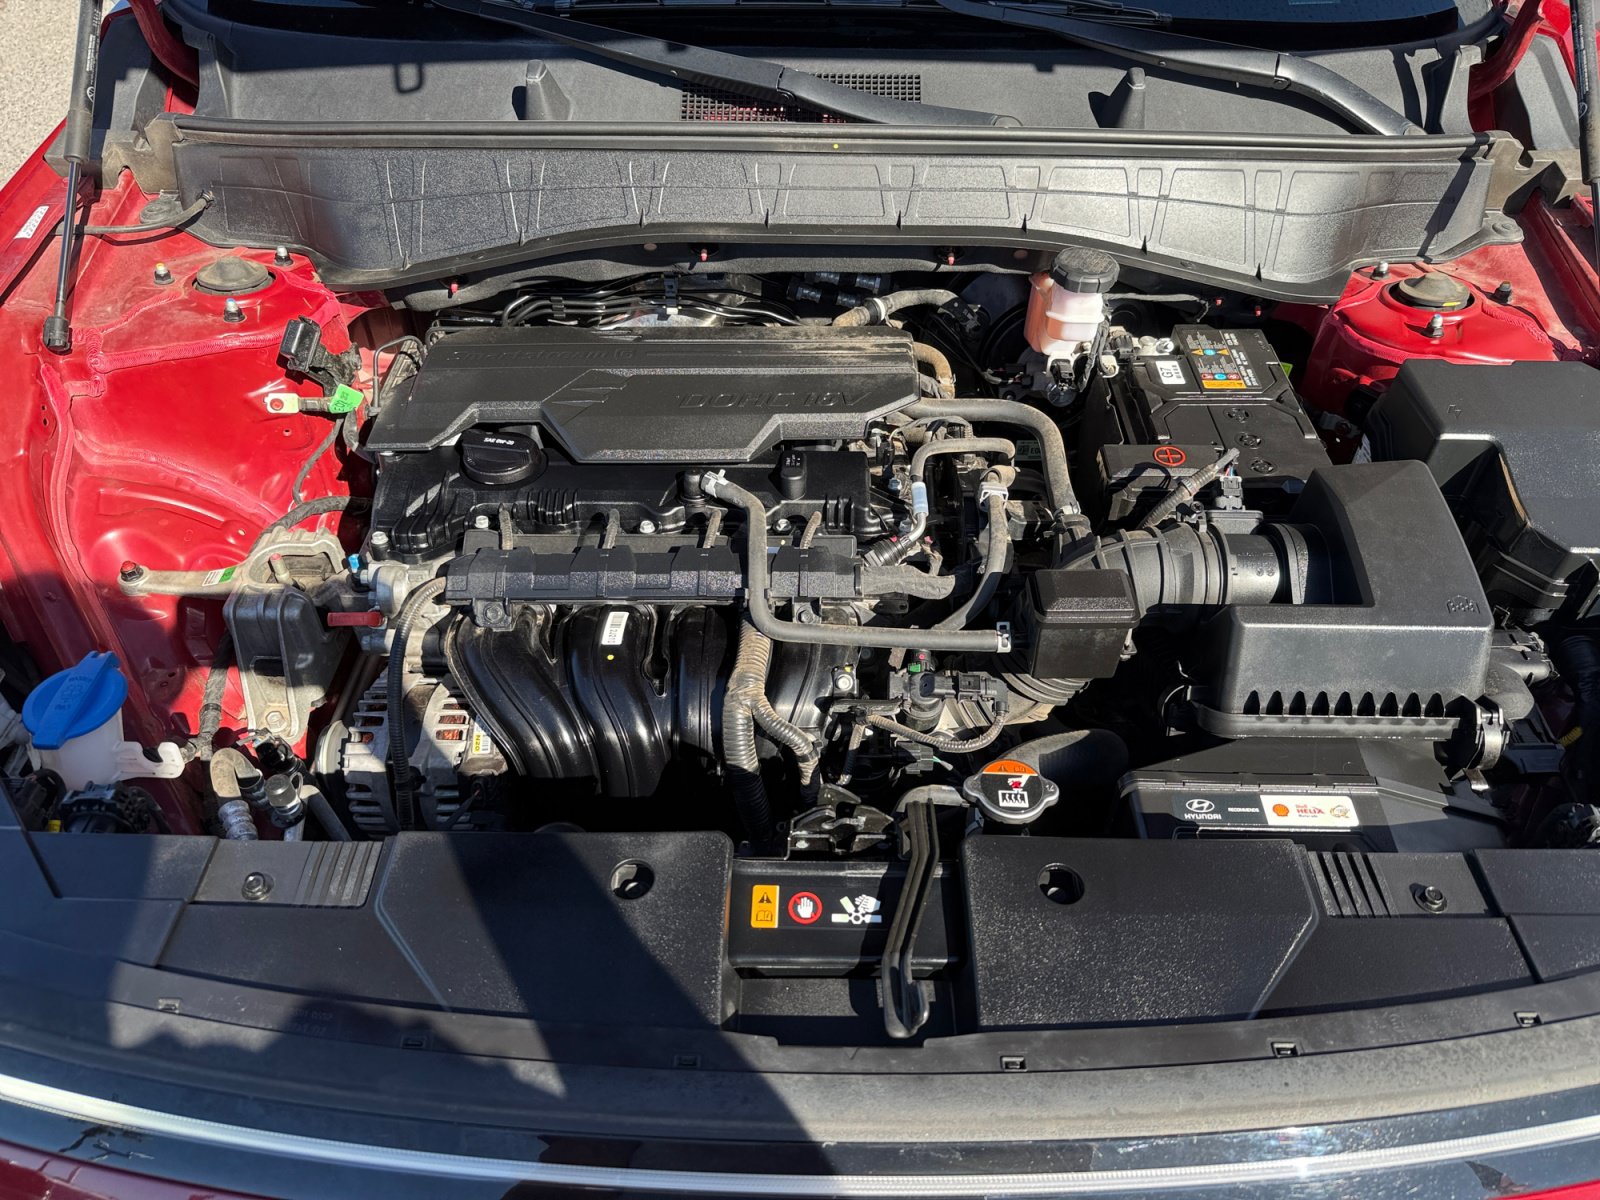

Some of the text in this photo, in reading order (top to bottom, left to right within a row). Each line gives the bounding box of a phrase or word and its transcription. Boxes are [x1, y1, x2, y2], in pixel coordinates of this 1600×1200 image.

[1161, 367, 1174, 378] G7
[679, 392, 795, 408] DOHC
[1297, 807, 1325, 815] HELIX
